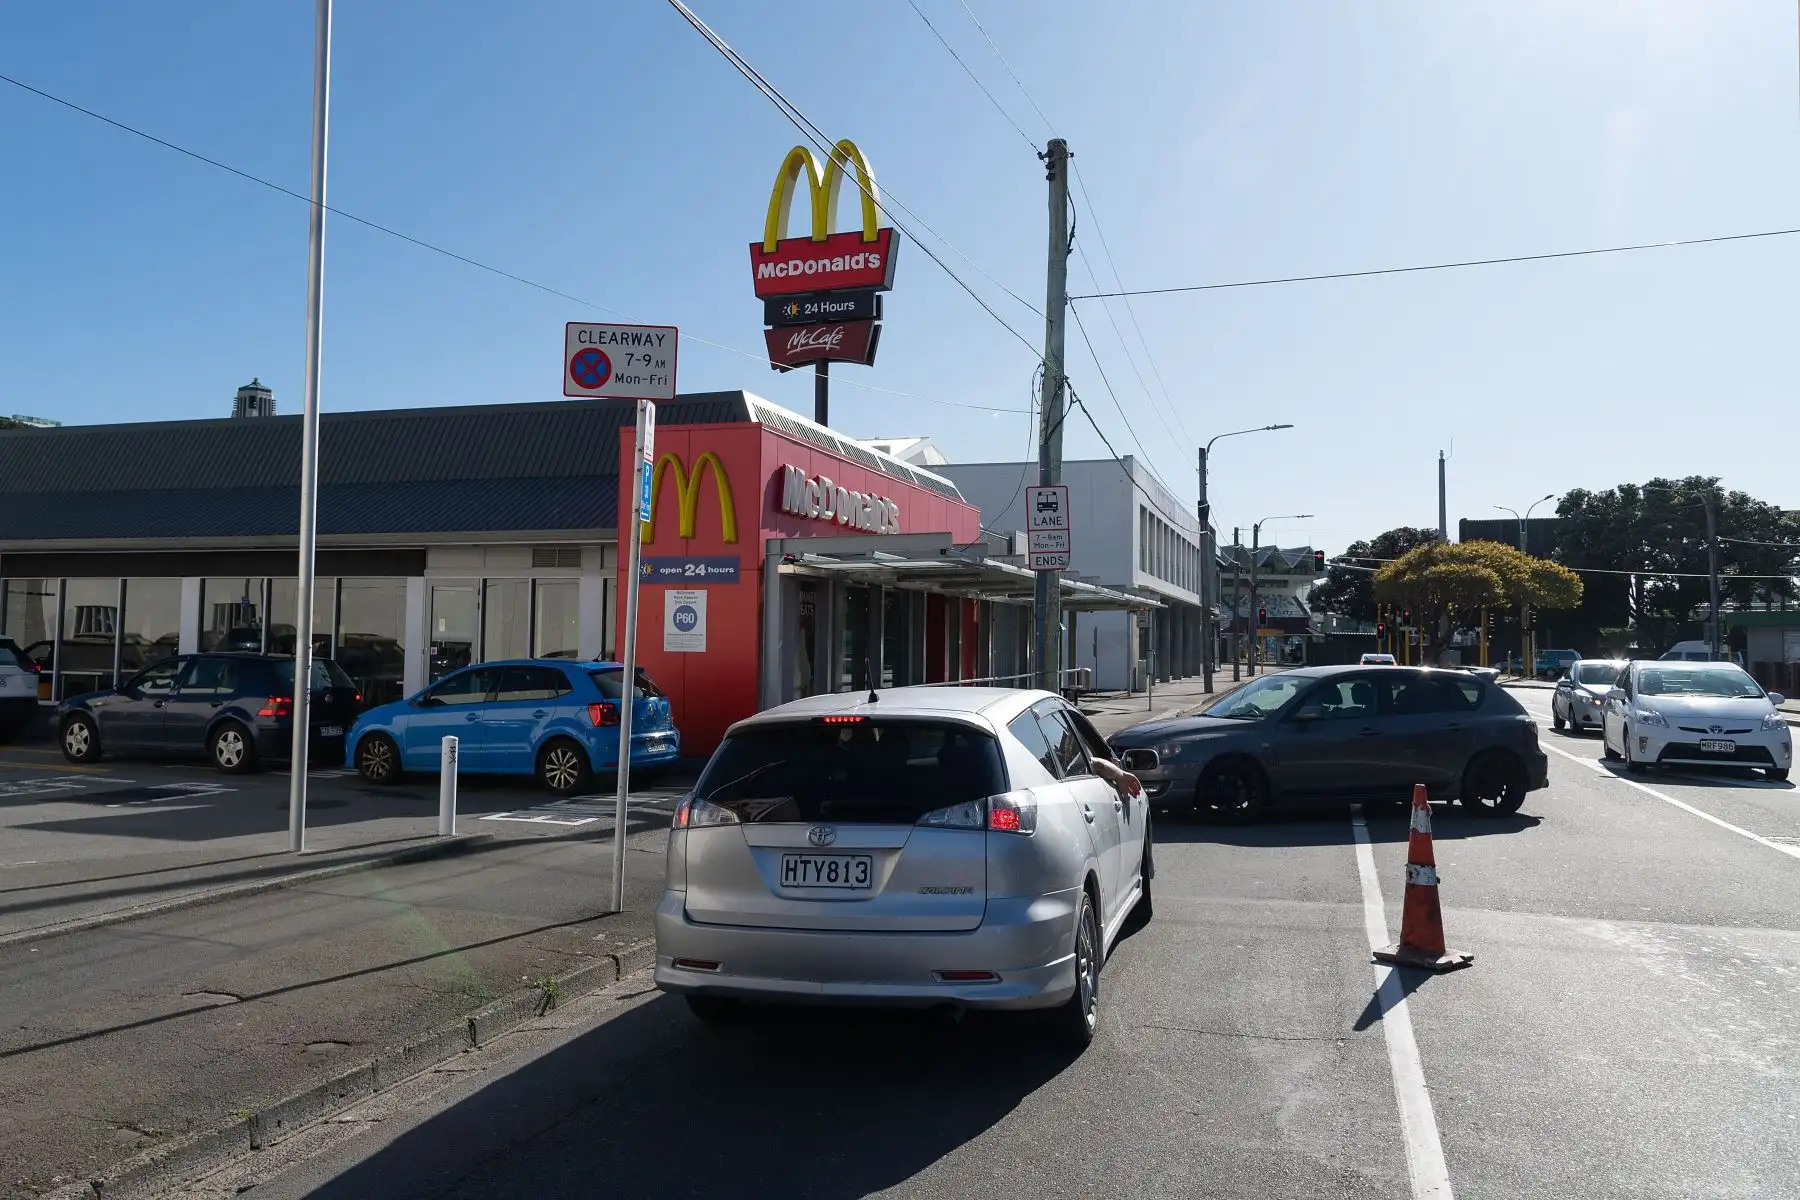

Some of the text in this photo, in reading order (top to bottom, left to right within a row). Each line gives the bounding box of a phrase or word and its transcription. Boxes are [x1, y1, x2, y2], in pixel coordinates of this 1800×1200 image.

[757, 252, 881, 279] McDonald's
[804, 301, 855, 314] 24 Hours
[578, 330, 666, 347] CLEARWAY
[787, 326, 844, 353] McCafé
[625, 353, 666, 369] 7-9 AM
[614, 373, 668, 386] Mon-Fri
[1034, 516, 1063, 526] LANE
[1035, 556, 1065, 566] ENDS
[684, 564, 707, 576] 24
[707, 564, 735, 573] hours
[676, 612, 695, 624] P60
[784, 859, 868, 884] HTY813
